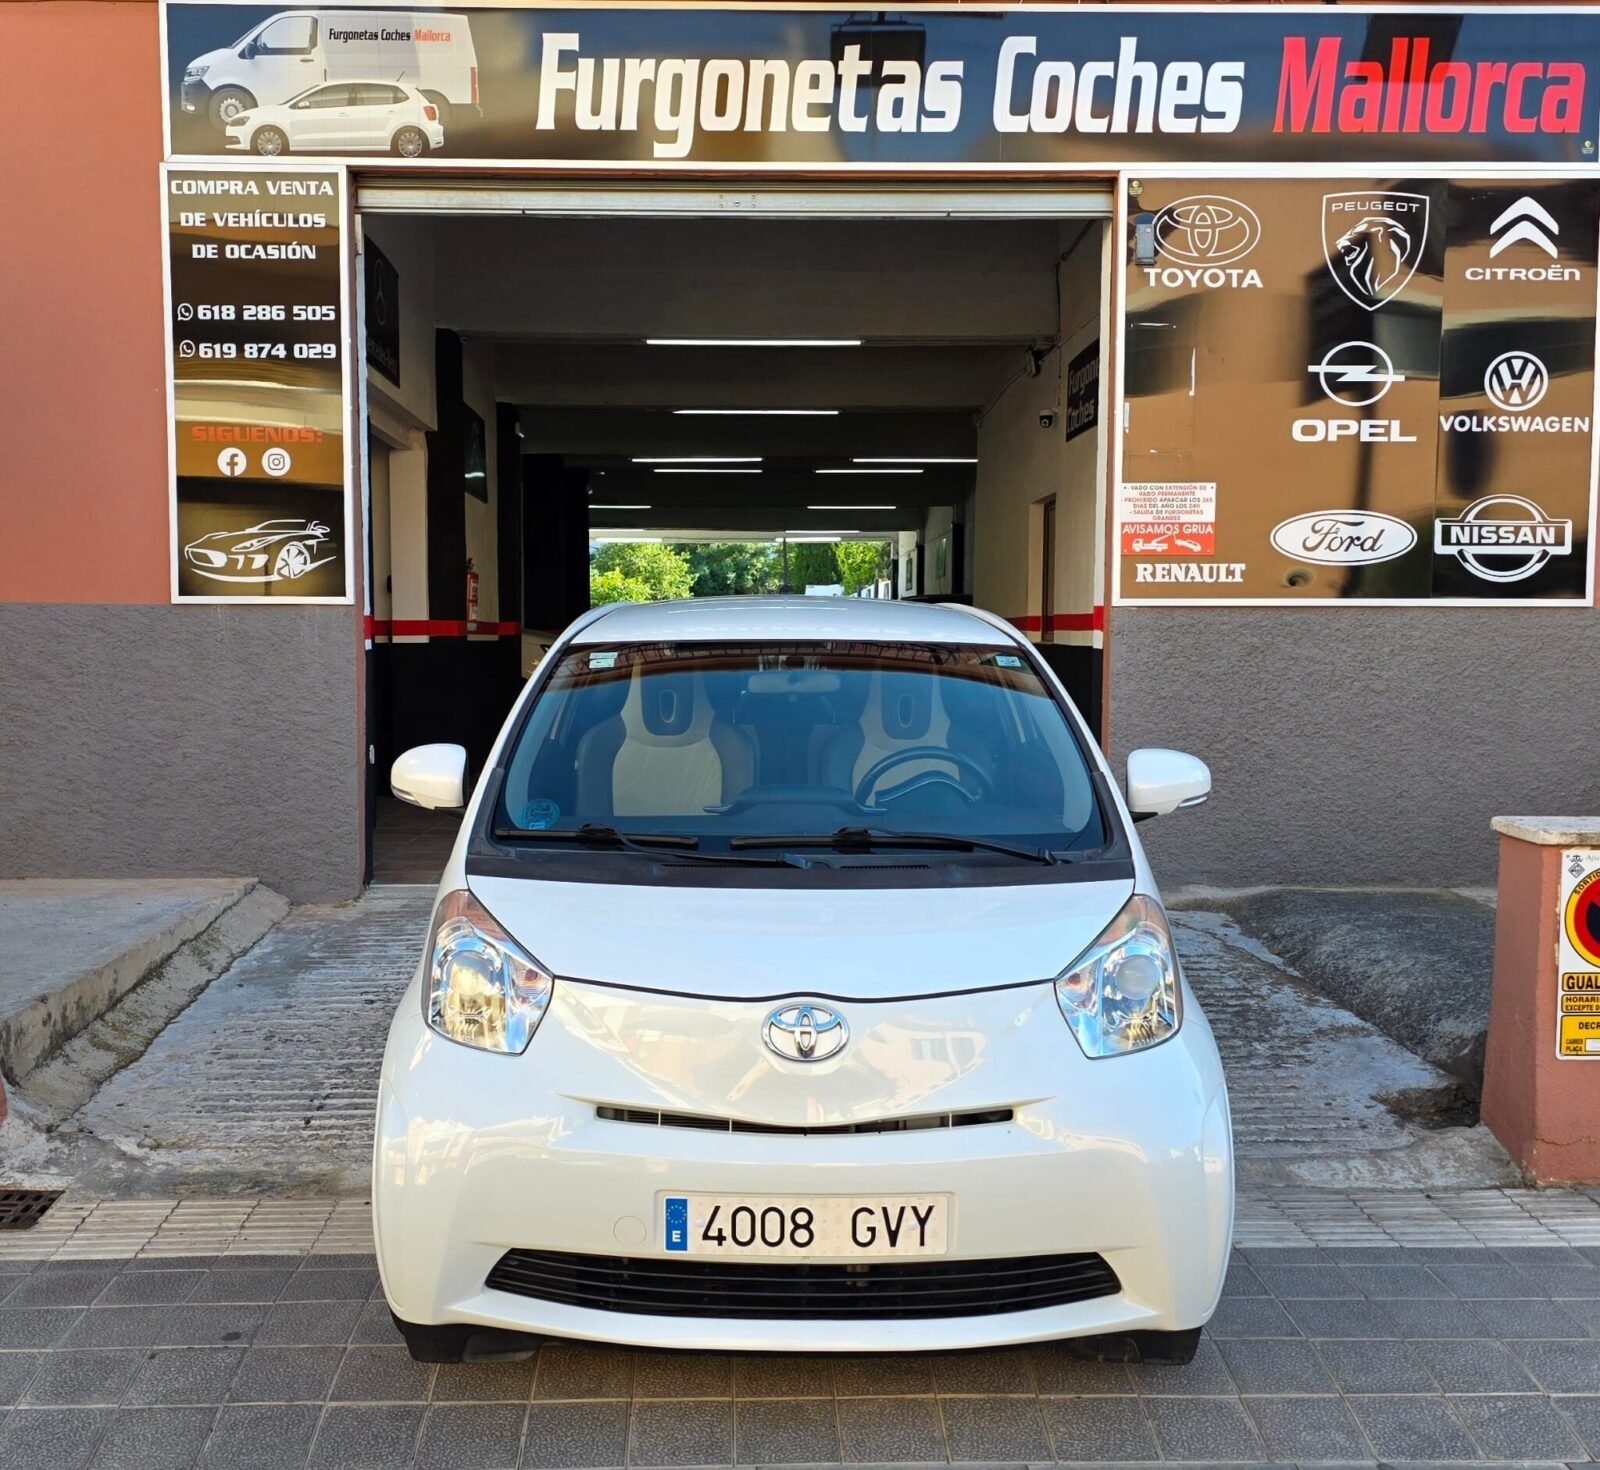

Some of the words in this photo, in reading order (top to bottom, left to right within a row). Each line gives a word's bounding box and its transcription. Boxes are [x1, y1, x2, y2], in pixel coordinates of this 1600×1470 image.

[328, 28, 378, 43] Furgonetas
[381, 28, 410, 41] Coches
[414, 29, 451, 41] Mallorca
[535, 32, 964, 158] Furgonetas
[992, 36, 1245, 134] Coches
[1272, 36, 1587, 134] Mallorca
[170, 180, 260, 196] COMPRA
[266, 180, 335, 196] VENTA
[1331, 201, 1421, 214] PEUGEOT
[180, 212, 207, 227] DE
[213, 210, 326, 228] VEHÍCULOS
[192, 244, 219, 259] DE
[225, 241, 317, 259] OCASIÓN
[1144, 267, 1264, 289] TOYOTA
[197, 305, 236, 321] 618
[243, 305, 286, 321] 286
[293, 305, 336, 321] 505
[199, 343, 237, 358] 619
[244, 343, 287, 358] 874
[293, 343, 337, 359] 029
[1292, 419, 1417, 442] OPEL
[1440, 415, 1590, 433] VOLKSWAGEN
[191, 425, 324, 443] SIGUENOS:
[1122, 524, 1180, 535] AVISAMOS
[1182, 524, 1214, 535] GRUA
[1301, 518, 1386, 553] Ford
[1450, 526, 1555, 544] NISSAN
[1135, 563, 1246, 583] RENAULT
[701, 1205, 815, 1248] 4008
[851, 1205, 935, 1248] GVY
[671, 1230, 682, 1242] E
